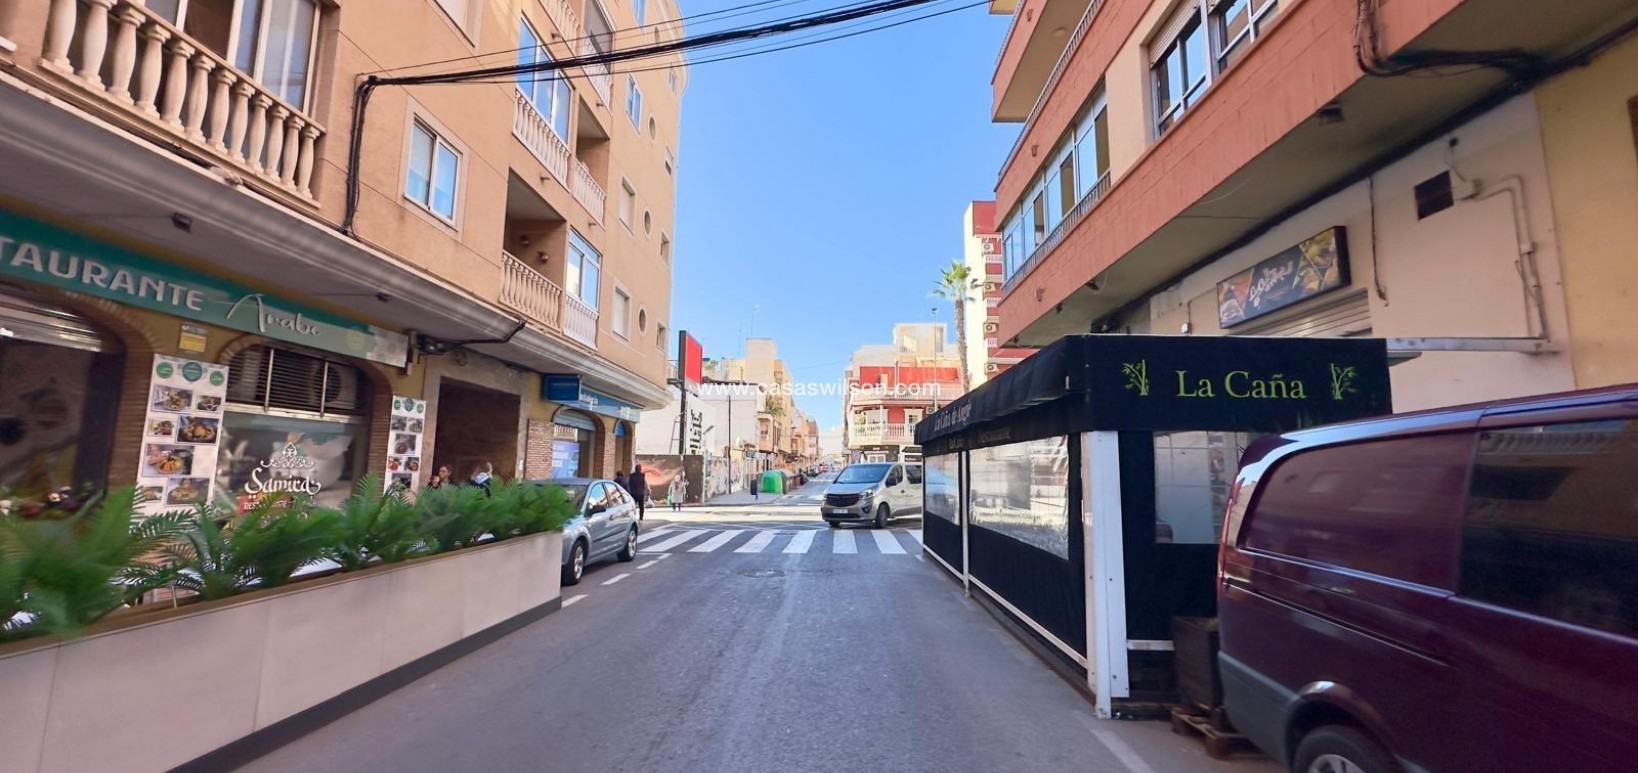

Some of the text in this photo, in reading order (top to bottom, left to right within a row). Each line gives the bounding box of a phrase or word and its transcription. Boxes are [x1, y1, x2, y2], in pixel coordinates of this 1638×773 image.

[226, 293, 321, 336] Arabe
[1175, 370, 1307, 398] La Caña
[244, 467, 322, 495] Samira
